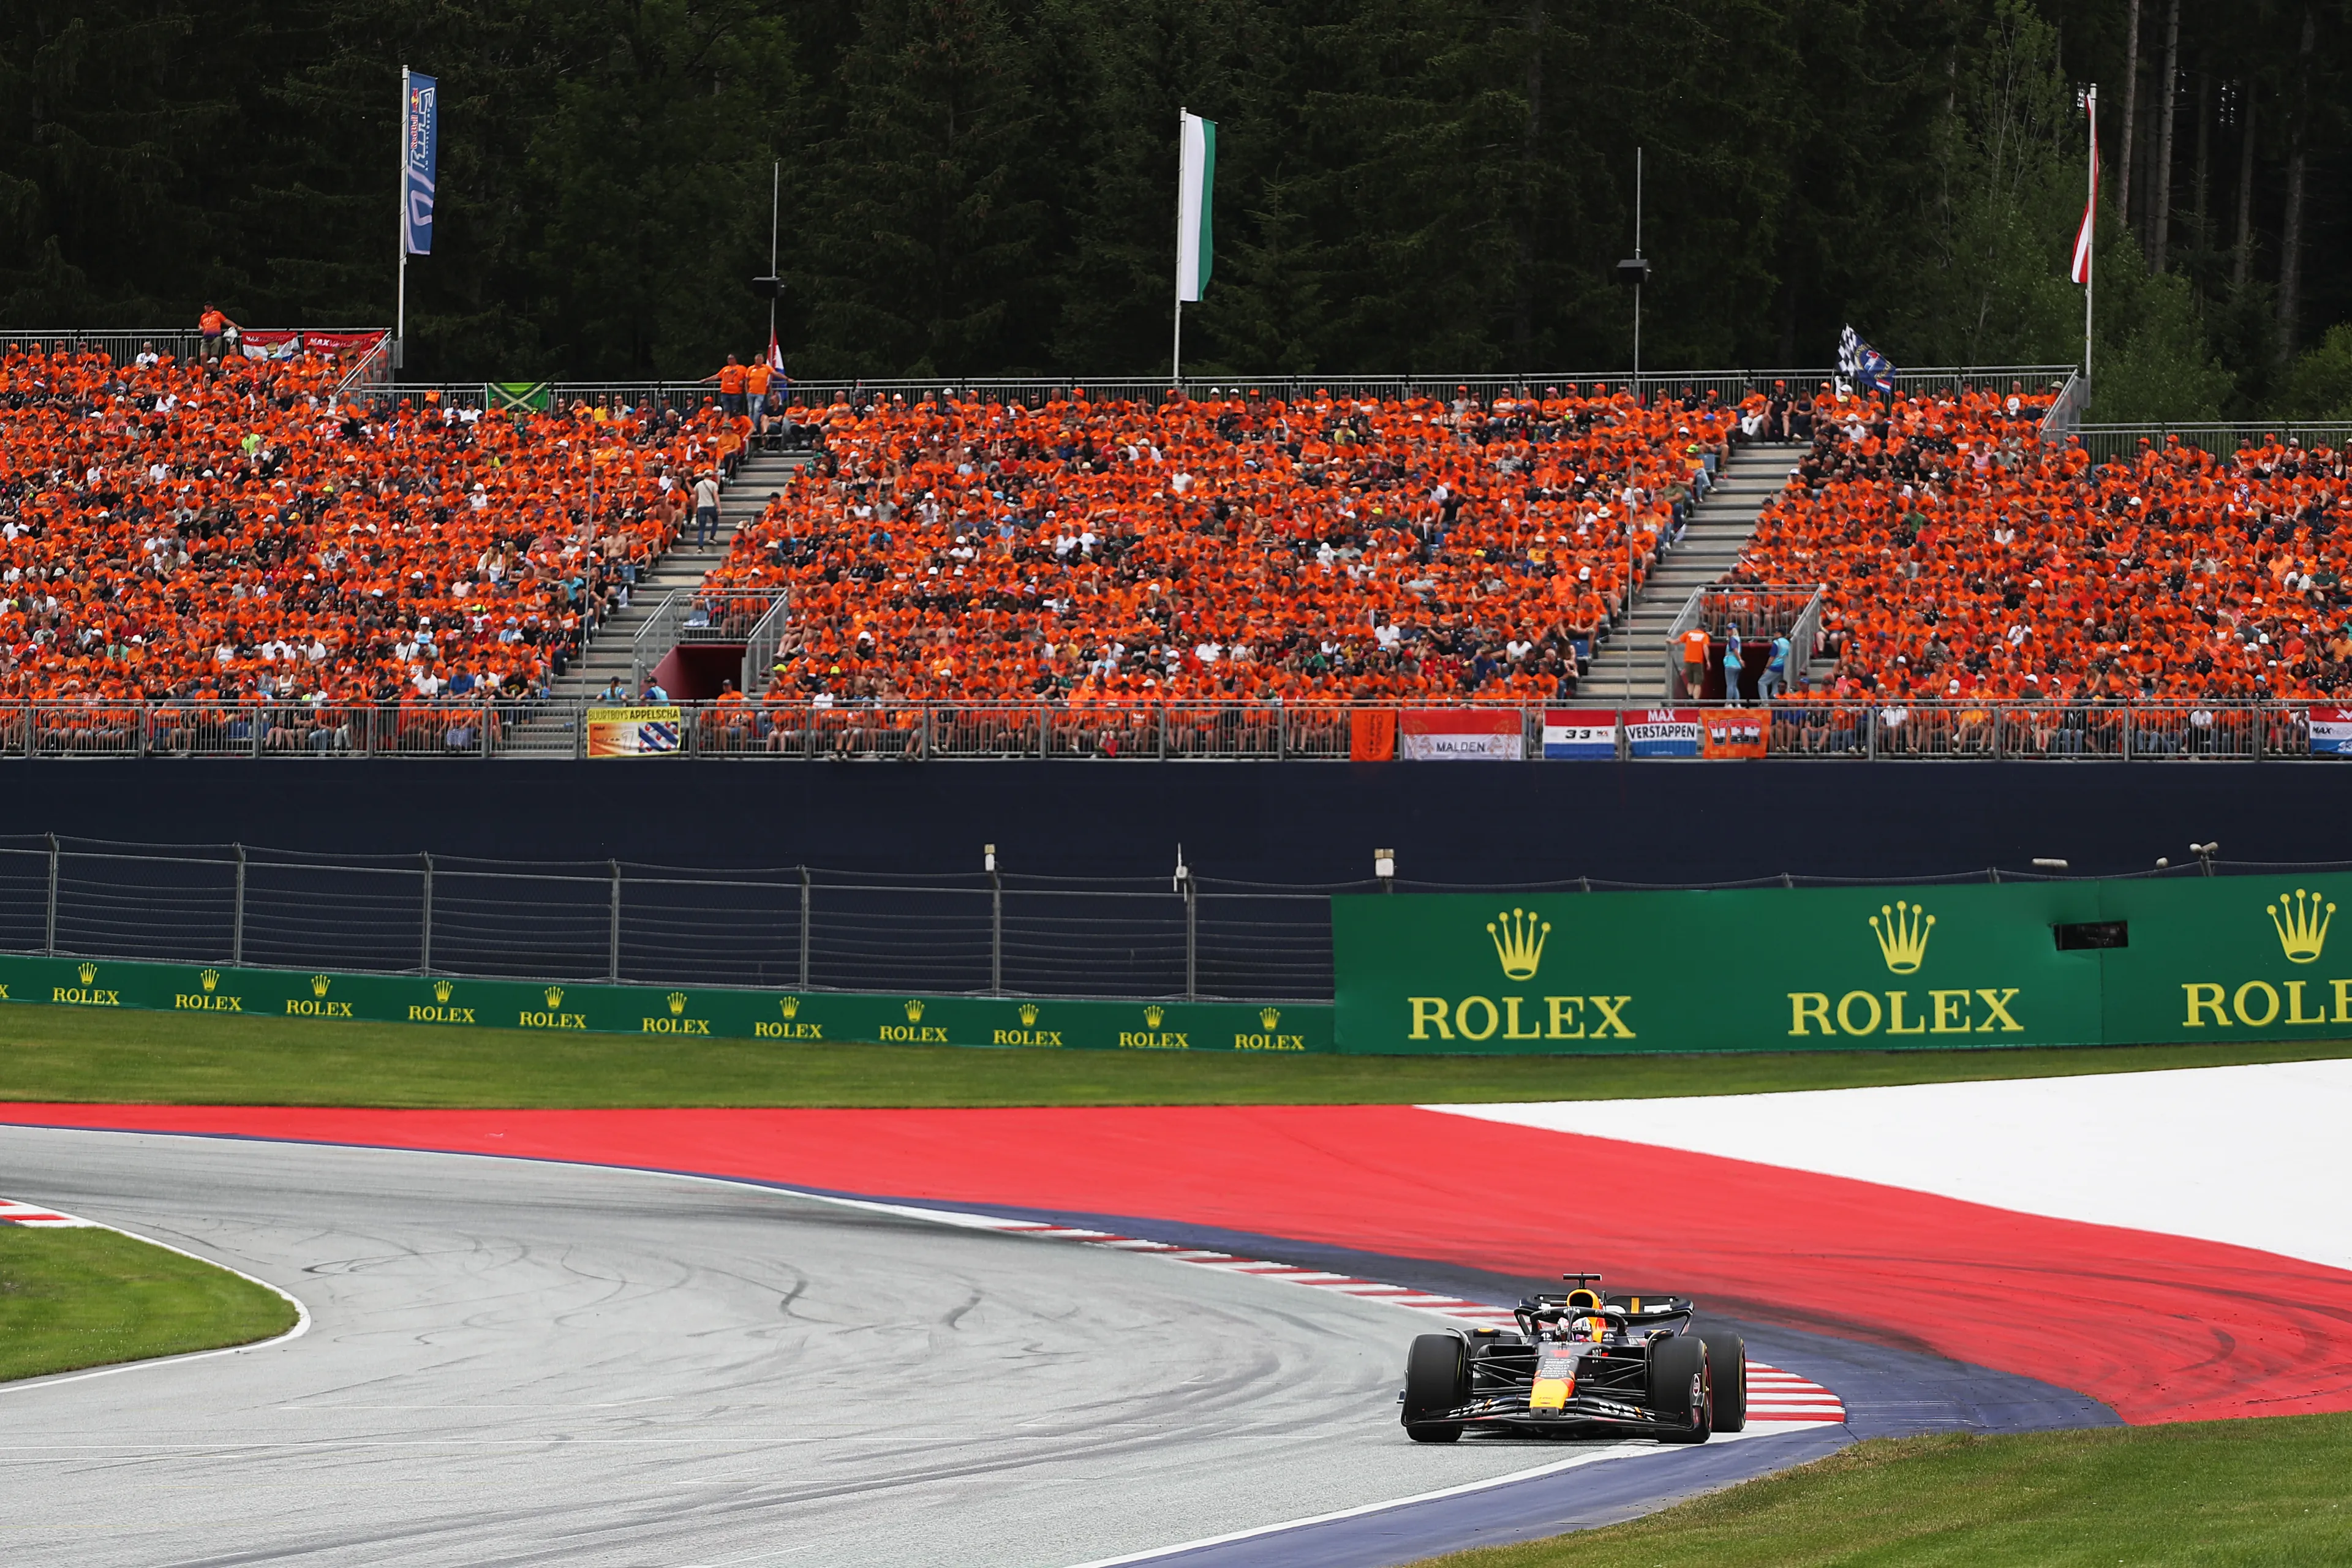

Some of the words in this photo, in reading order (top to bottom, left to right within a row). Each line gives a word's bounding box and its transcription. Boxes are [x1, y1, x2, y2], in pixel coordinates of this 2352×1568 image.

[589, 710, 628, 720] BUURTBOYS
[630, 709, 679, 719] APPELSCHA
[1648, 709, 1675, 722] MAX
[1565, 729, 1591, 739] 33
[1629, 725, 1695, 739] VERSTAPPEN
[1436, 742, 1485, 753] MALDEN
[53, 987, 119, 1005] ROLEX
[175, 993, 241, 1011] ROLEX
[287, 1000, 353, 1017] ROLEX
[409, 1006, 475, 1023] ROLEX
[1787, 987, 2024, 1036] ROLEX
[519, 1011, 586, 1029] ROLEX
[643, 1017, 710, 1035] ROLEX
[1408, 995, 1636, 1041] ROLEX
[755, 1022, 822, 1039] ROLEX
[880, 1025, 948, 1042] ROLEX
[993, 1029, 1062, 1046] ROLEX
[1119, 1031, 1188, 1049] ROLEX
[1234, 1033, 1305, 1050] ROLEX
